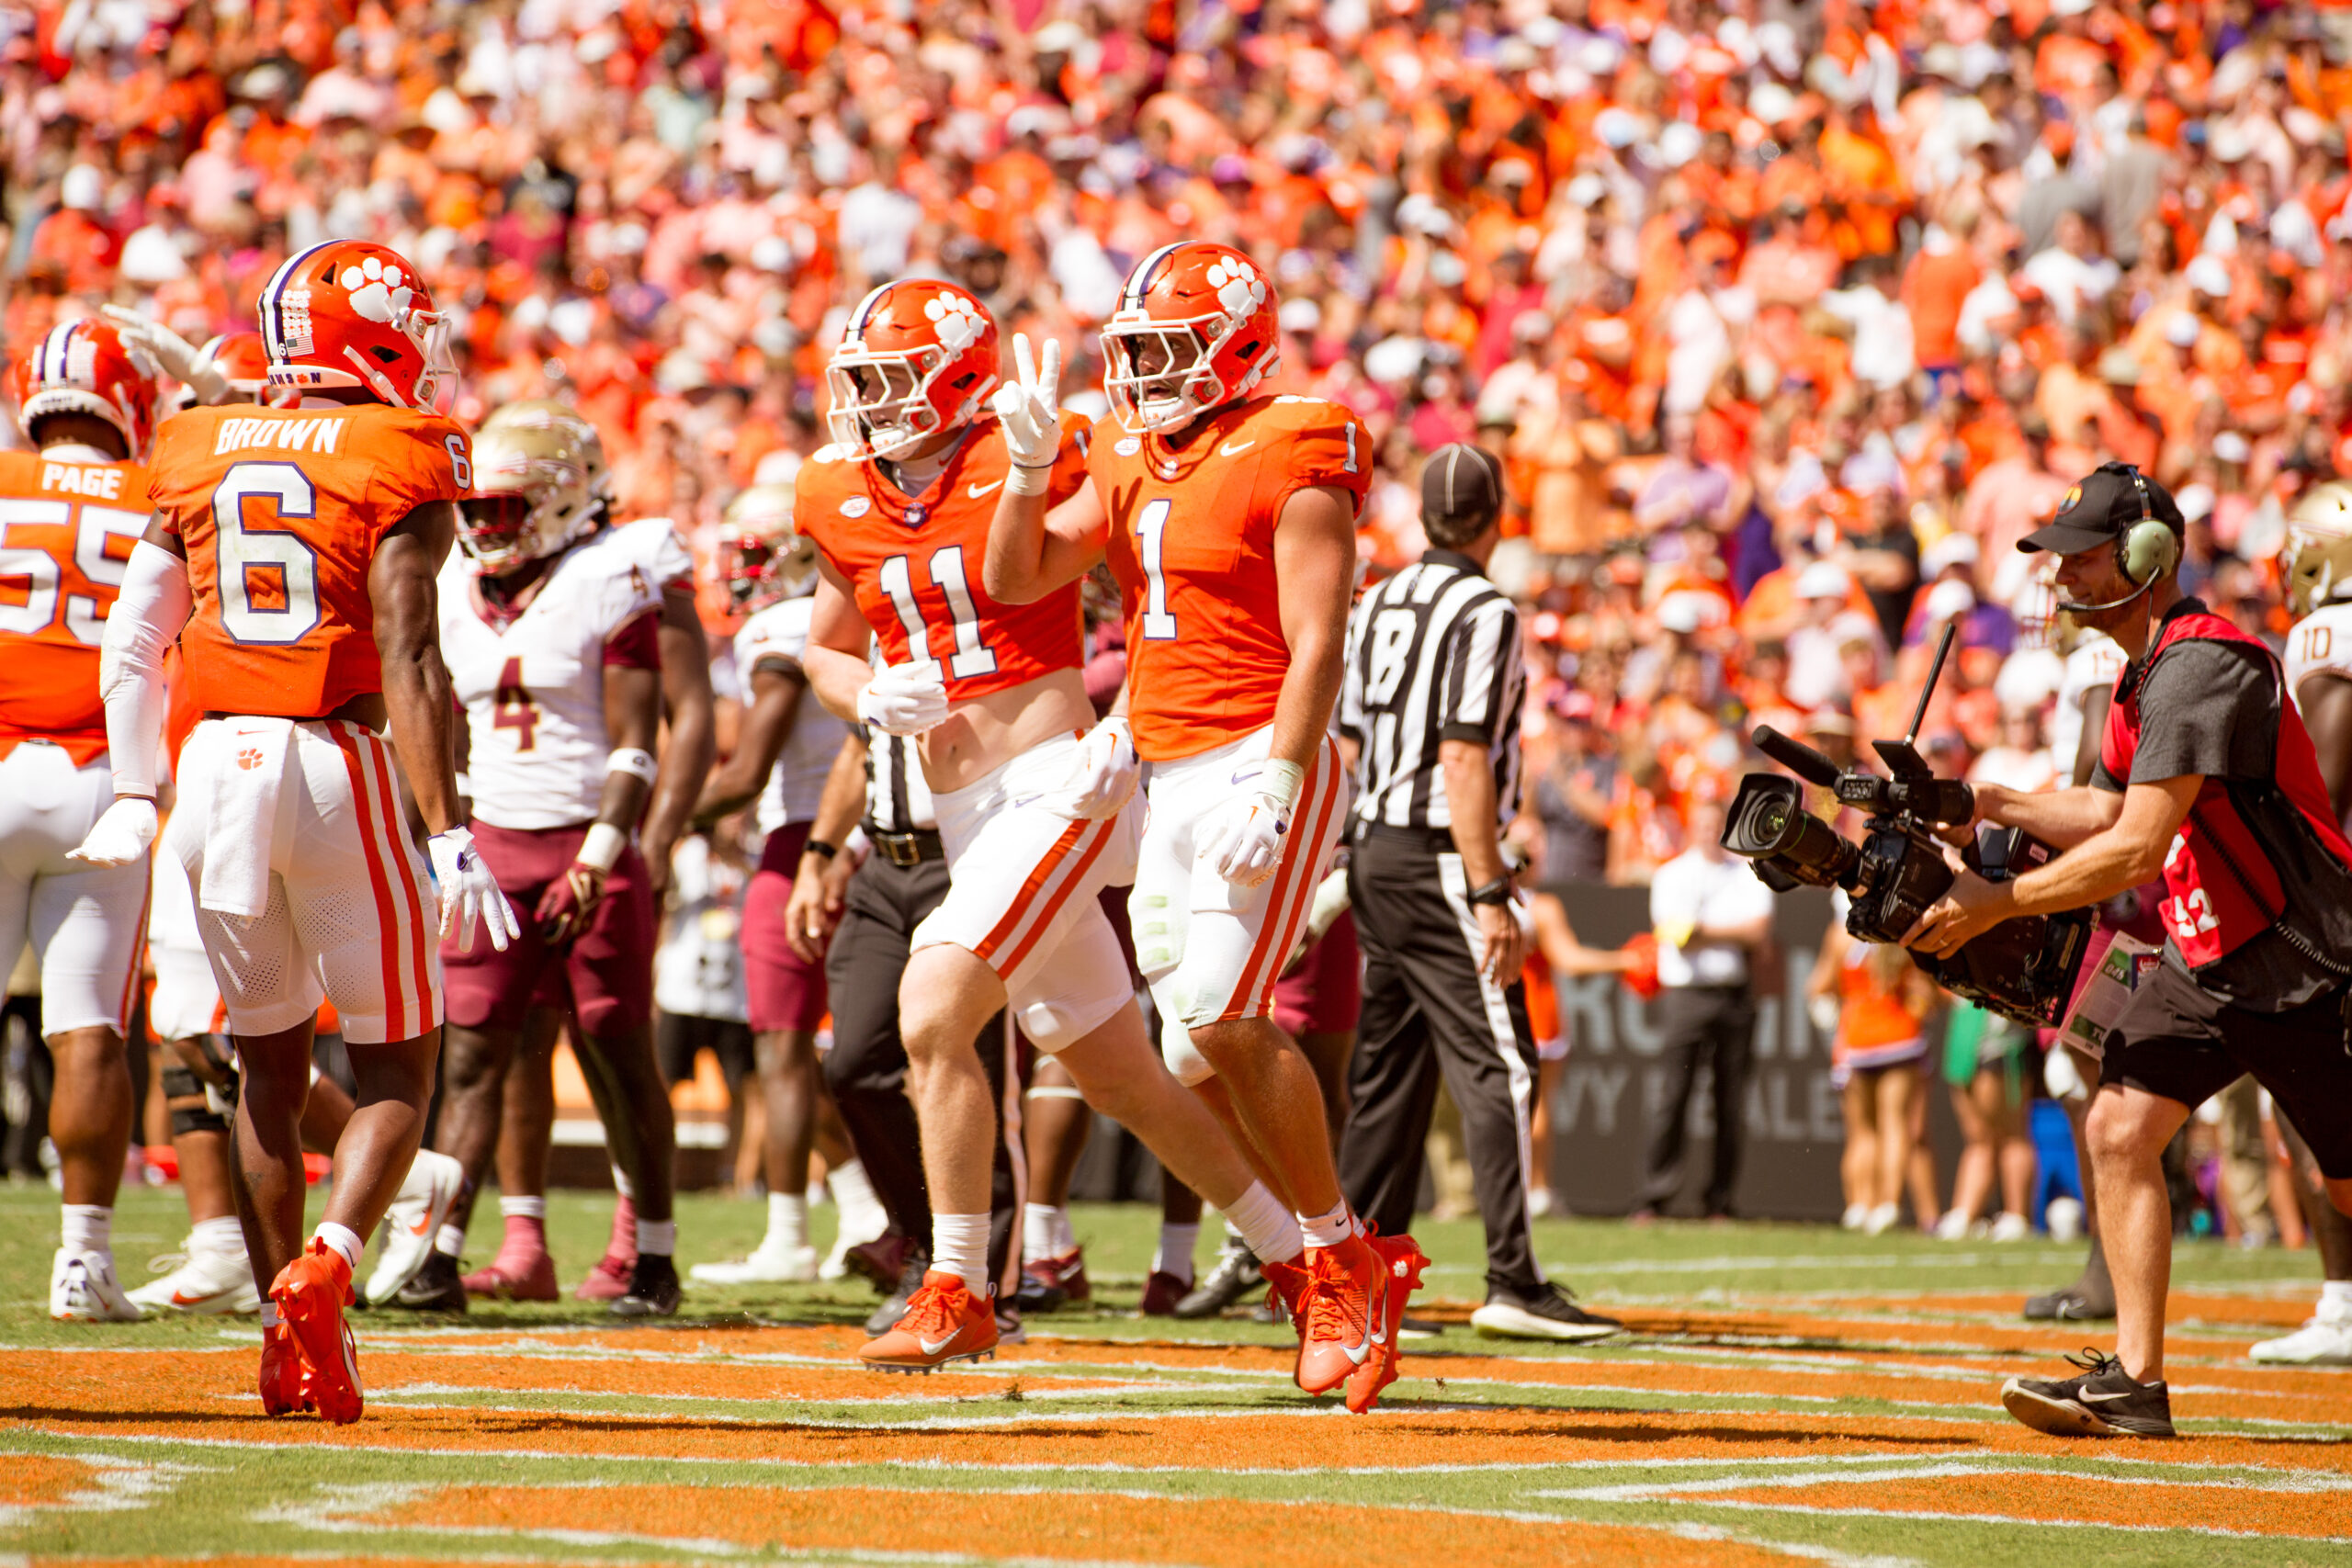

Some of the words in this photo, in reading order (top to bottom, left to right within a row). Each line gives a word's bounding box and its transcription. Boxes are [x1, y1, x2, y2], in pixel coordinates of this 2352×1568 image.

[277, 343, 287, 356] 6
[214, 418, 345, 456] BROWN
[444, 433, 471, 490] 6
[1343, 422, 1359, 473] 1
[41, 462, 124, 500] PAGE
[0, 497, 153, 649] 55
[211, 460, 322, 646] 6
[1135, 498, 1177, 640] 1
[879, 544, 999, 682] 11
[2302, 626, 2332, 662] 10
[1364, 608, 1417, 705] B
[492, 655, 541, 753] 4
